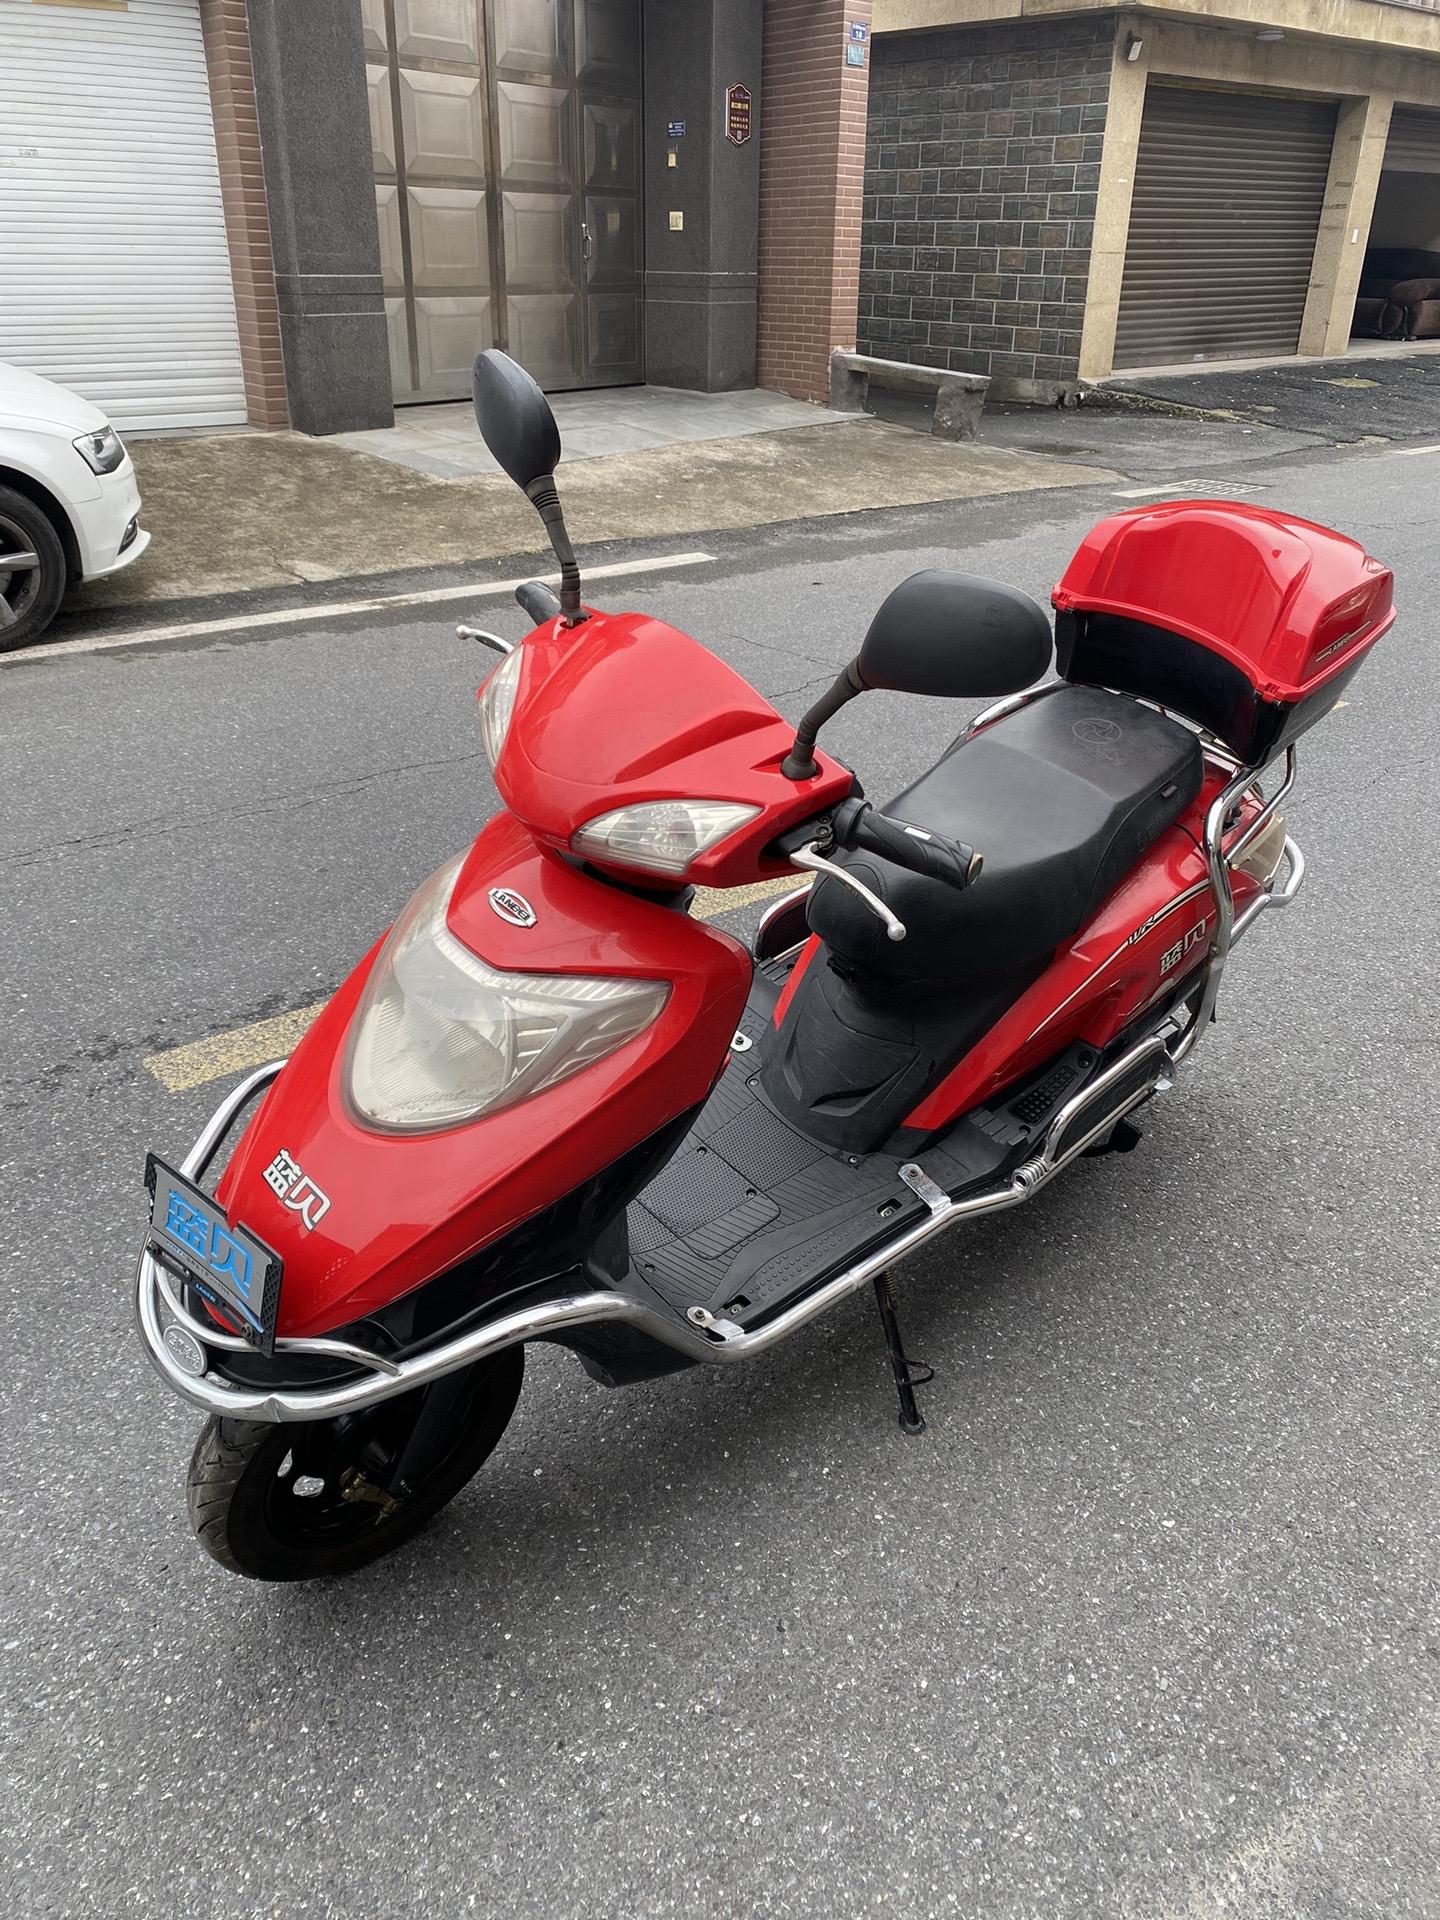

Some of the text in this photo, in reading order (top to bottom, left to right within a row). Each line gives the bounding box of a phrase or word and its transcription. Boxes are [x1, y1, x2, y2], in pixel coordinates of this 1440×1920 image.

[492, 890, 531, 921] LANBEI
[1159, 918, 1206, 976] 蓝贝
[262, 1148, 333, 1231] 蓝贝
[164, 1189, 253, 1299] 蓝贝
